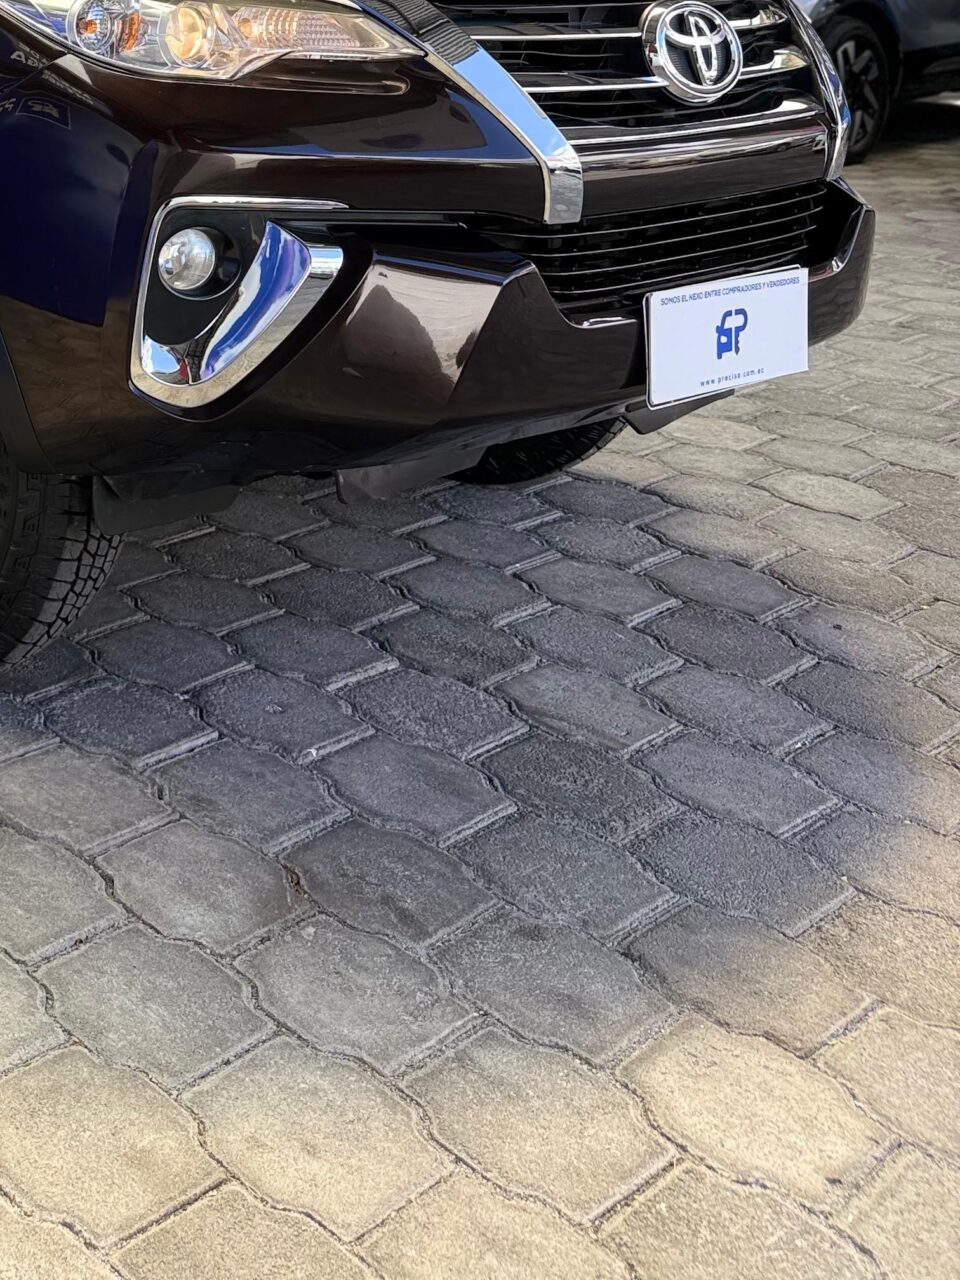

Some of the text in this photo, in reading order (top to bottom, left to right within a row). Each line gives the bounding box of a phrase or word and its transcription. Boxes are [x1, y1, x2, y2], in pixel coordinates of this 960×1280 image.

[660, 295, 680, 306] SOMOS
[681, 294, 688, 303] EL
[689, 291, 703, 301] NEXO
[704, 289, 721, 299] ENTRE
[722, 283, 762, 296] COMPRADORES
[767, 277, 800, 289] VENDEDORES
